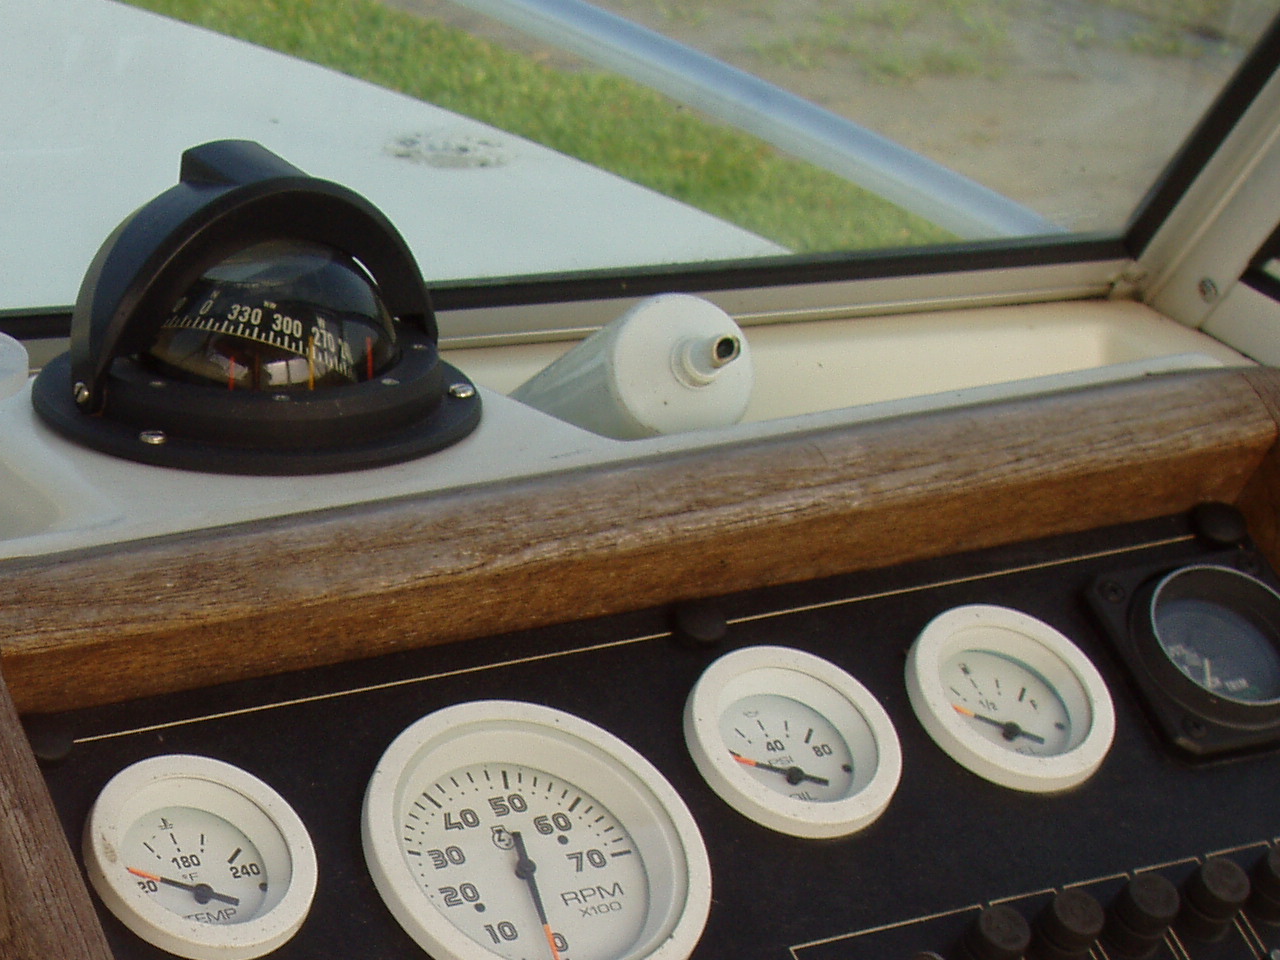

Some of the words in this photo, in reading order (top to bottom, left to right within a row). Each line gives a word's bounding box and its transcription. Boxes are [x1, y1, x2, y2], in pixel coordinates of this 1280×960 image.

[199, 299, 214, 315] 0
[227, 303, 262, 325] 330
[272, 313, 302, 338] 300
[311, 326, 336, 352] 270
[766, 739, 785, 752] 40
[812, 743, 833, 757] 80
[488, 793, 528, 817] 50
[444, 808, 480, 831] 40
[533, 812, 572, 835] 60
[171, 854, 201, 870] 180
[427, 846, 466, 870] 30
[566, 849, 607, 872] 70
[230, 863, 260, 879] 240
[438, 883, 480, 907] 20
[560, 882, 624, 907] RPM
[580, 901, 622, 918] X100
[484, 921, 519, 945] 10
[552, 932, 569, 953] 0
